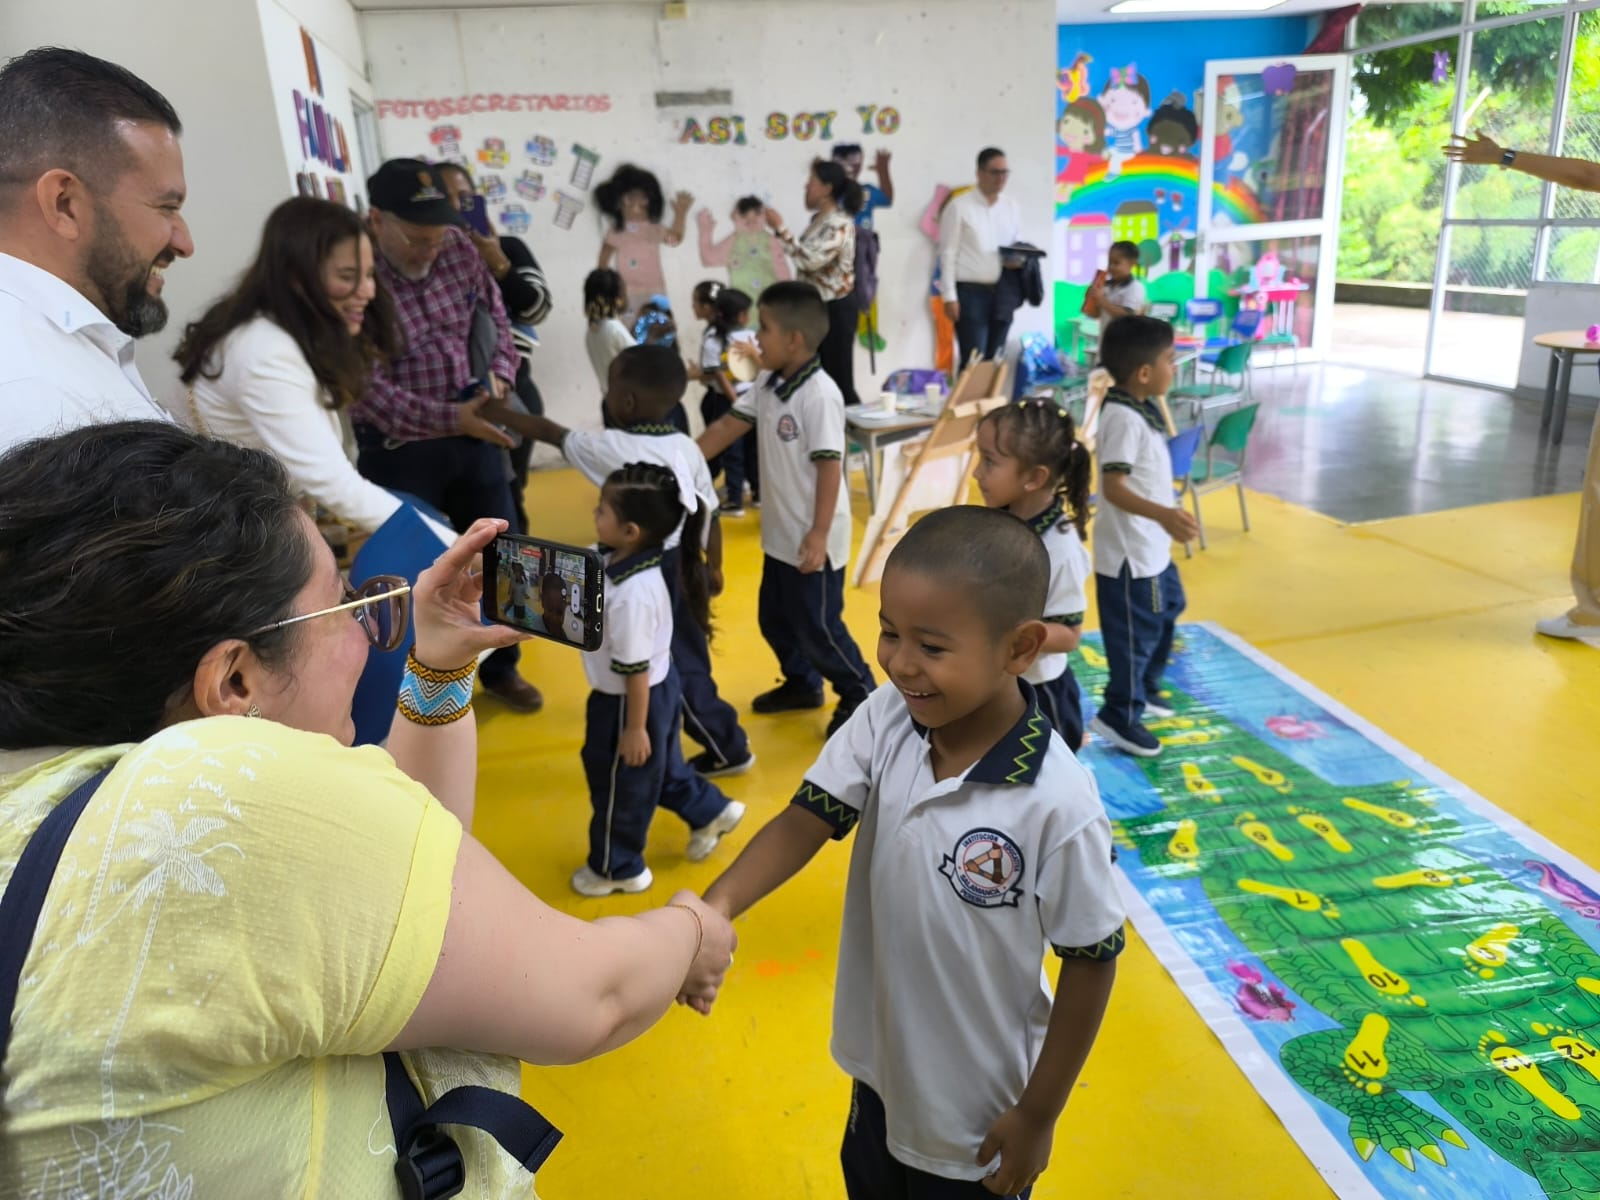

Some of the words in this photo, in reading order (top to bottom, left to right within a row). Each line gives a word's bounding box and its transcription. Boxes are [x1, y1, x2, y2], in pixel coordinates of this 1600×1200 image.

[376, 93, 612, 121] FOTOSECRETARIOS
[679, 116, 747, 145] ASI
[765, 111, 836, 141] SOY
[856, 103, 901, 135] YO
[1295, 892, 1310, 905] 7
[1368, 971, 1400, 989] 10
[1349, 1050, 1381, 1071] 11
[1557, 1043, 1597, 1060] 12
